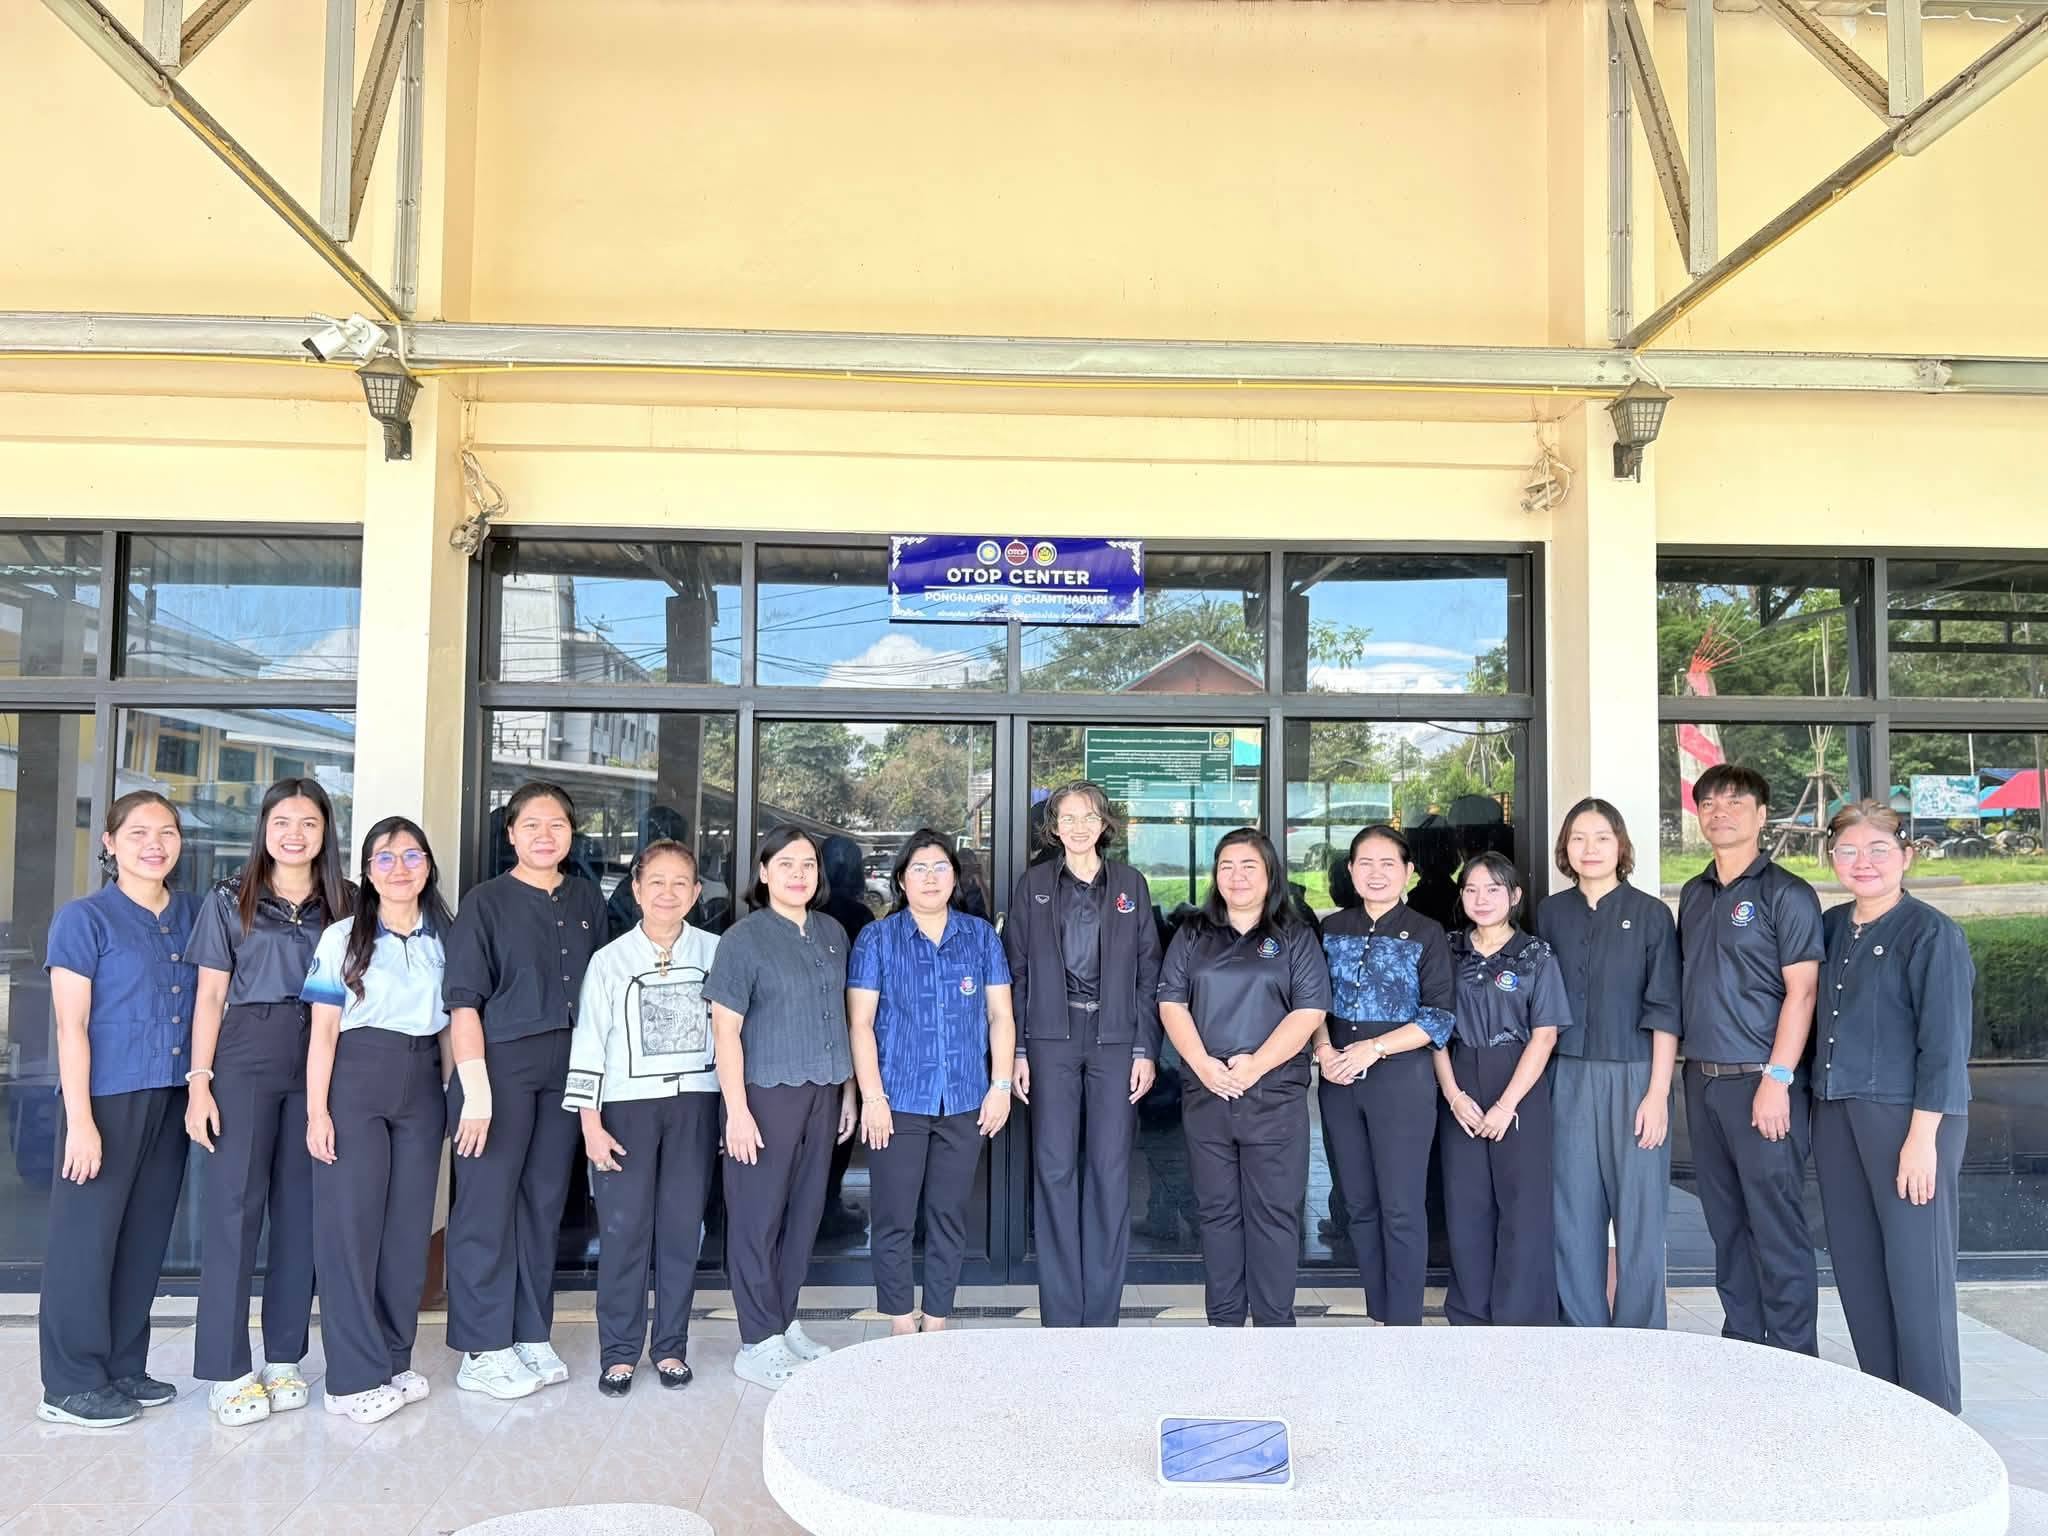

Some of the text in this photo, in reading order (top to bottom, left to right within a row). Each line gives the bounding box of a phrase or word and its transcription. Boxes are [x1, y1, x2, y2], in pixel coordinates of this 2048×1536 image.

[947, 568, 1090, 585] OTOP CENTER
[1011, 593, 1107, 606] @CHANTHABURI
